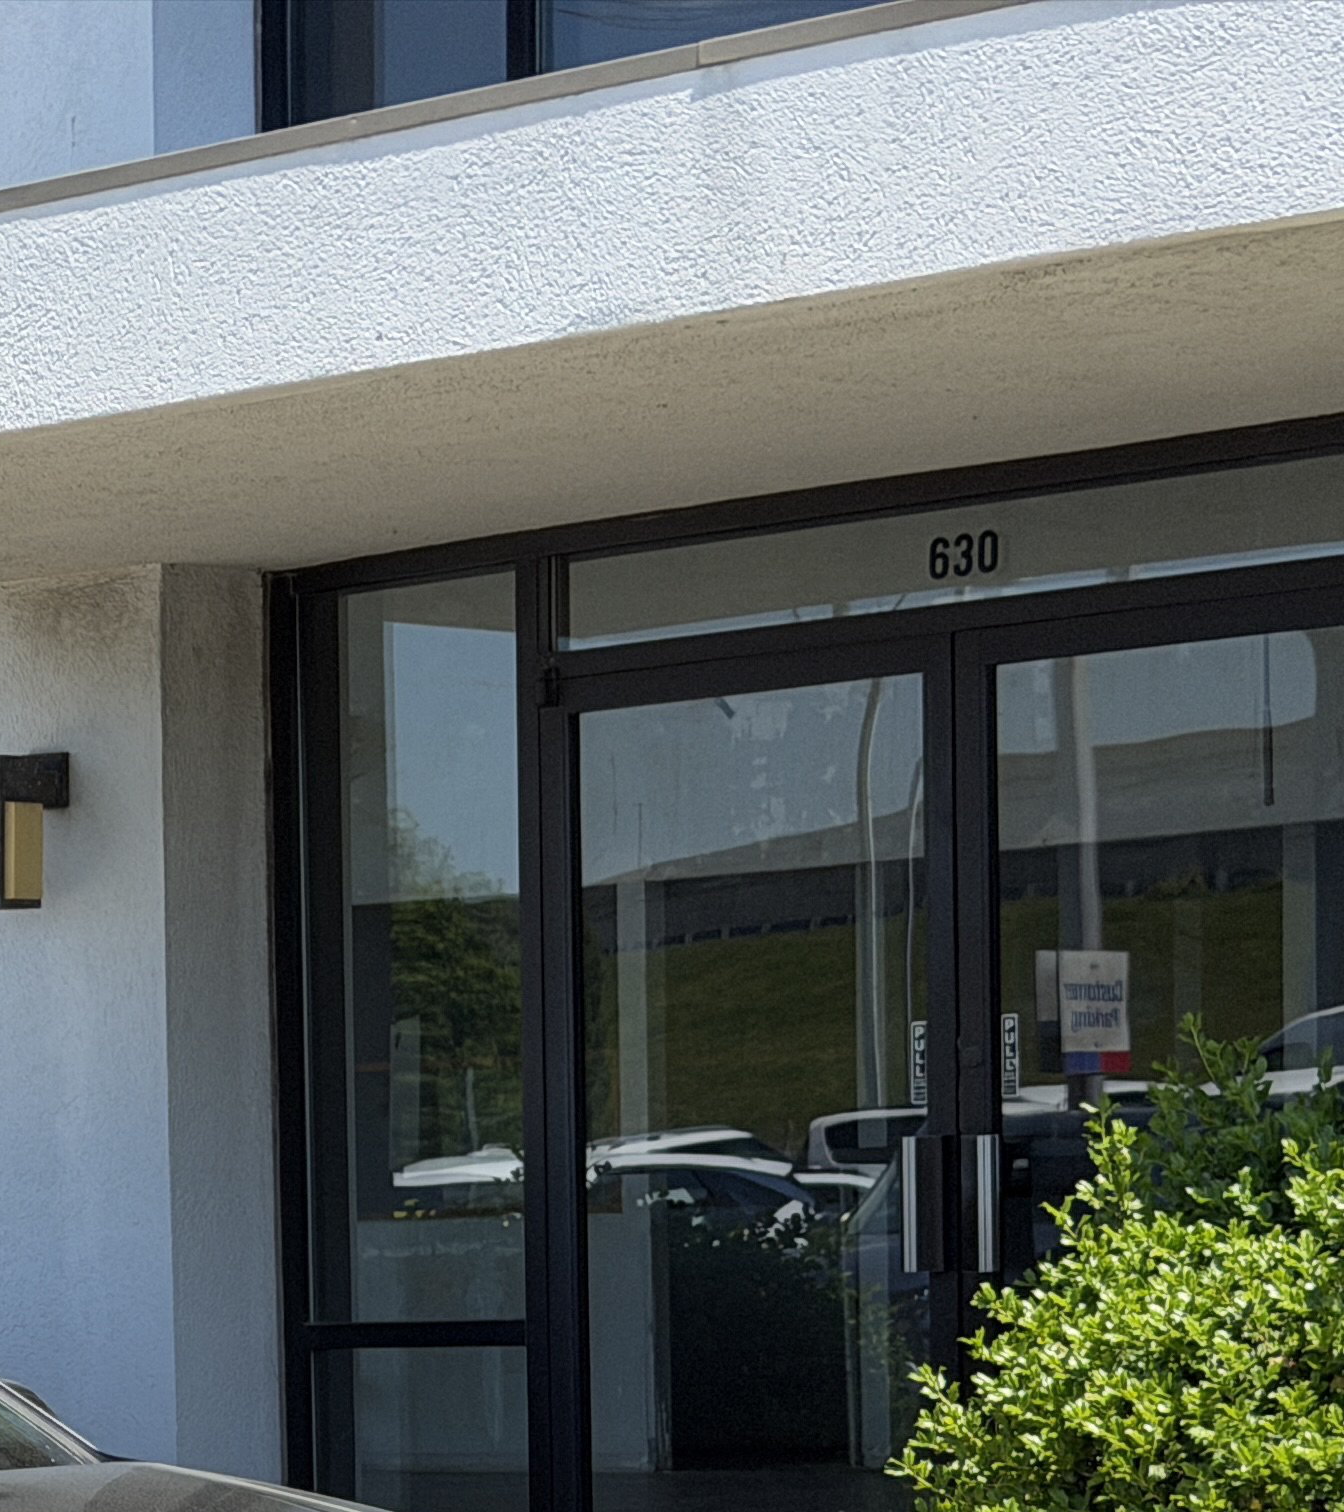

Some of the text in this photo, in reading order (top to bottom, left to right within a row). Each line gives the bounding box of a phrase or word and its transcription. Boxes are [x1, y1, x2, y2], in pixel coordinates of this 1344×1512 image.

[929, 529, 999, 580] 630
[914, 1026, 925, 1077] PULL
[1004, 1018, 1016, 1071] PULL
